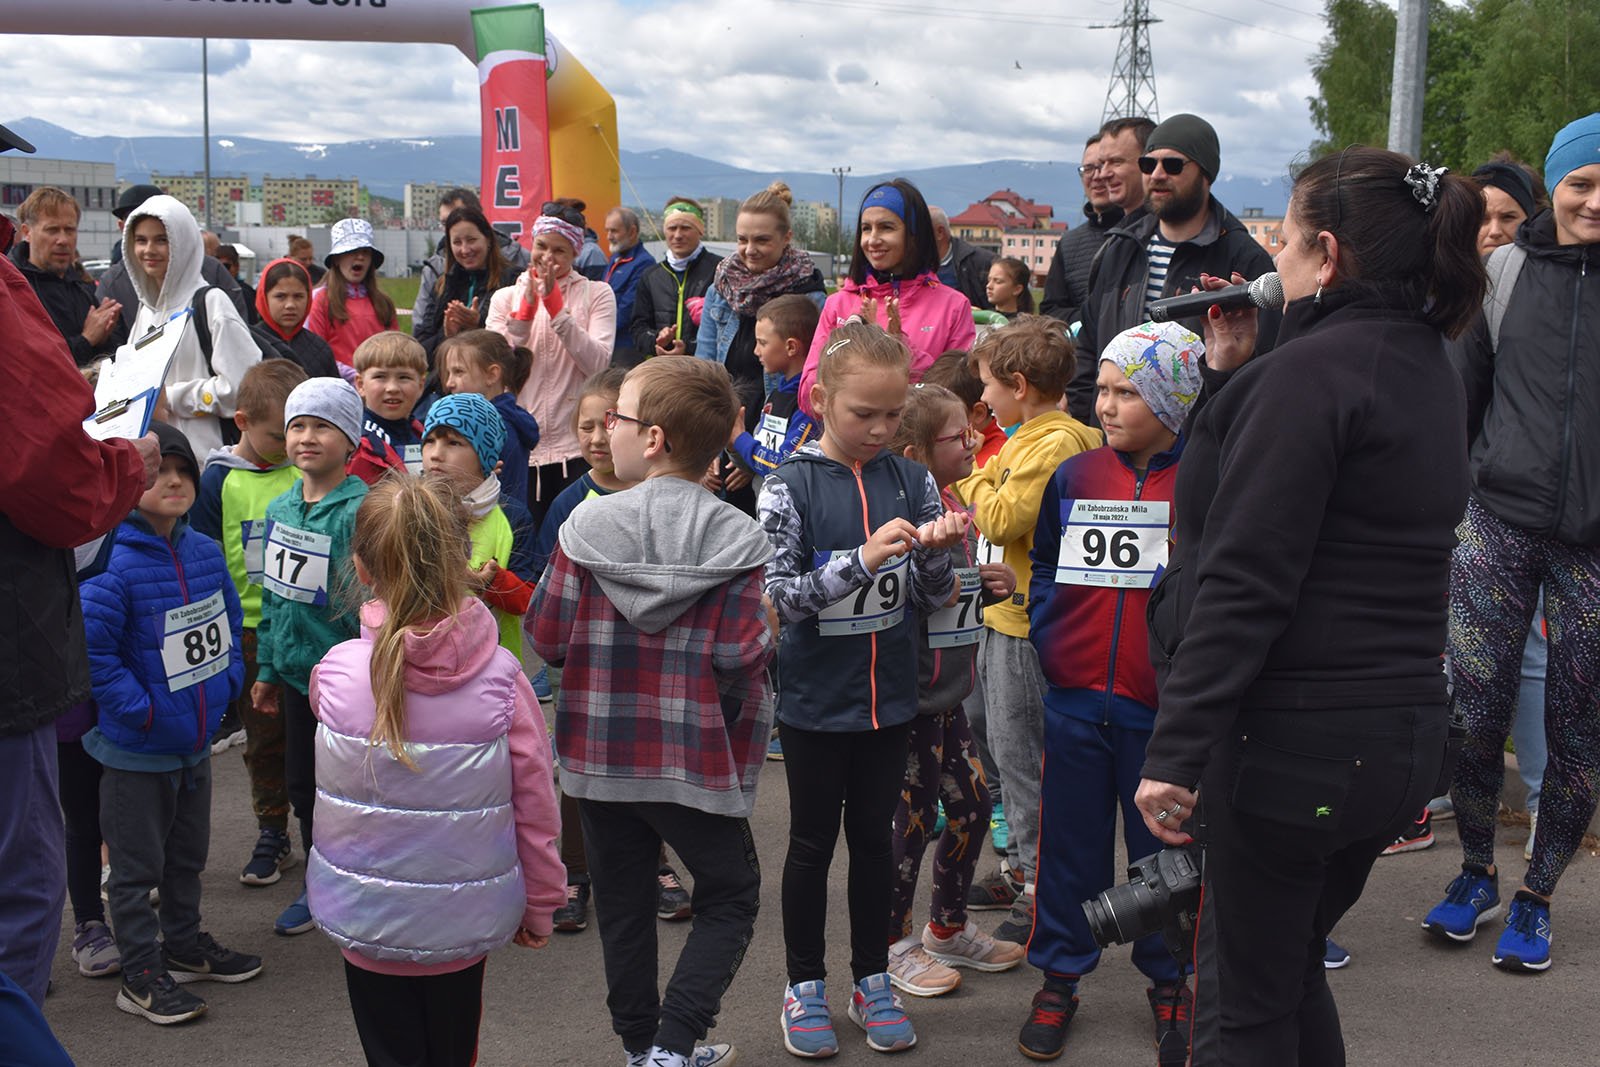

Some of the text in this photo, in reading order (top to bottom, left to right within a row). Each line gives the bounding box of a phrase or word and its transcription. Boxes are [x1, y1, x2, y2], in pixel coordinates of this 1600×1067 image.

[1131, 505, 1148, 514] Mila
[275, 548, 309, 585] 17
[1082, 528, 1140, 569] 96
[853, 572, 900, 616] 79
[183, 622, 222, 667] 89
